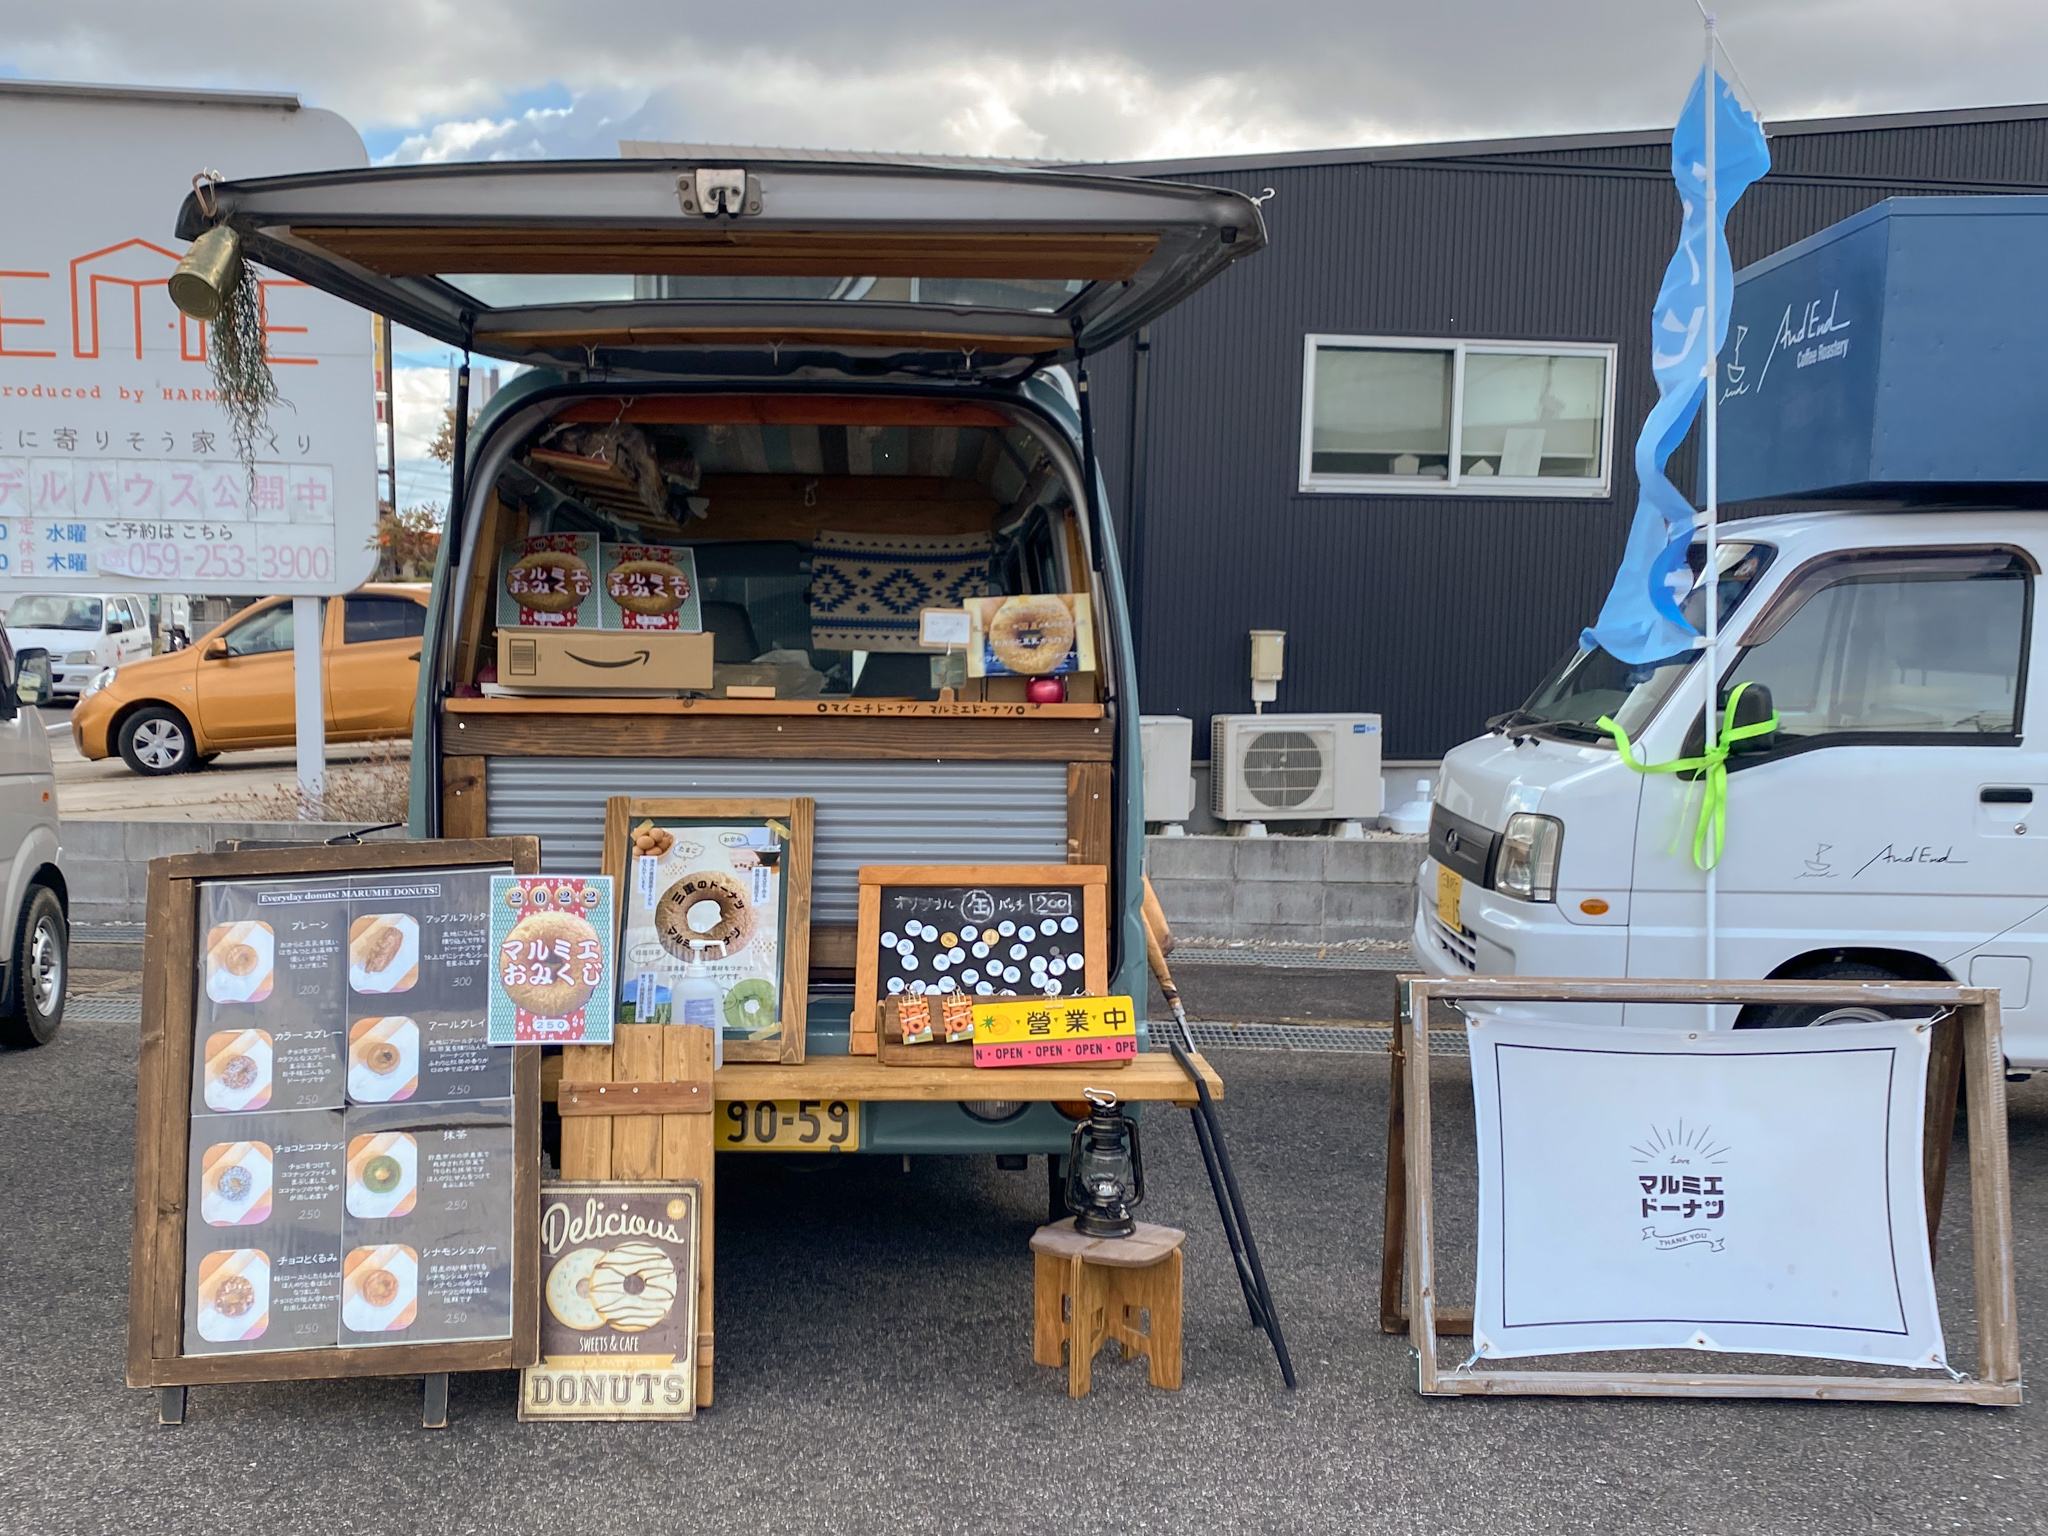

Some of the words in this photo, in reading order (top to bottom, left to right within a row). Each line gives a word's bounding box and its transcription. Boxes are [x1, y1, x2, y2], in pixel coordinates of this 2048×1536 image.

[119, 386, 144, 403] by
[0, 426, 311, 455] に寄りそう家くり
[46, 525, 87, 543] 水曜
[46, 553, 88, 572] 木曜
[127, 542, 329, 579] 059-253-3900
[508, 567, 589, 582] マルミエ
[608, 572, 687, 586] マルミエ
[509, 579, 592, 597] おみくじ
[610, 583, 690, 599] おみくじ
[929, 704, 1013, 715] マルミエドーナツ
[261, 893, 303, 903] Everyday
[305, 891, 339, 900] donuts!
[341, 889, 392, 898] MARUMIE
[394, 887, 438, 896] DONUTS!
[425, 912, 490, 924] アップルフリッタ
[291, 921, 329, 931] プレーン
[502, 938, 599, 961] マルミエ
[503, 962, 603, 986] おみくじ
[452, 976, 472, 986] 300
[299, 985, 320, 995] 200
[428, 1018, 486, 1031] アールグレイ
[536, 1021, 565, 1029] 250
[274, 1029, 343, 1041] カラースプレー
[996, 1047, 1023, 1059] OPEN
[1036, 1045, 1062, 1057] OPEN
[1075, 1043, 1102, 1056] OPEN
[1115, 1041, 1136, 1054] OPE
[448, 1084, 470, 1095] 250
[295, 1094, 318, 1105] 250
[727, 1100, 850, 1144] 90-59
[274, 1142, 345, 1154] チョコとココナッツ
[1670, 1155, 1690, 1165] Love
[1638, 1175, 1724, 1195] マルミエ
[445, 1200, 468, 1211] 250
[1641, 1198, 1724, 1219] ドーナツ
[298, 1209, 321, 1220] 250
[541, 1199, 684, 1255] Delicious
[1659, 1236, 1688, 1246] THANK
[423, 1245, 496, 1258] シナモンシュガー
[277, 1253, 337, 1266] チョコとくるみ
[444, 1313, 467, 1324] 250
[295, 1323, 319, 1335] 250
[580, 1336, 608, 1352] SWEETS
[610, 1335, 617, 1352] &
[620, 1336, 639, 1352] CAFE
[531, 1374, 685, 1406] DONUTS
